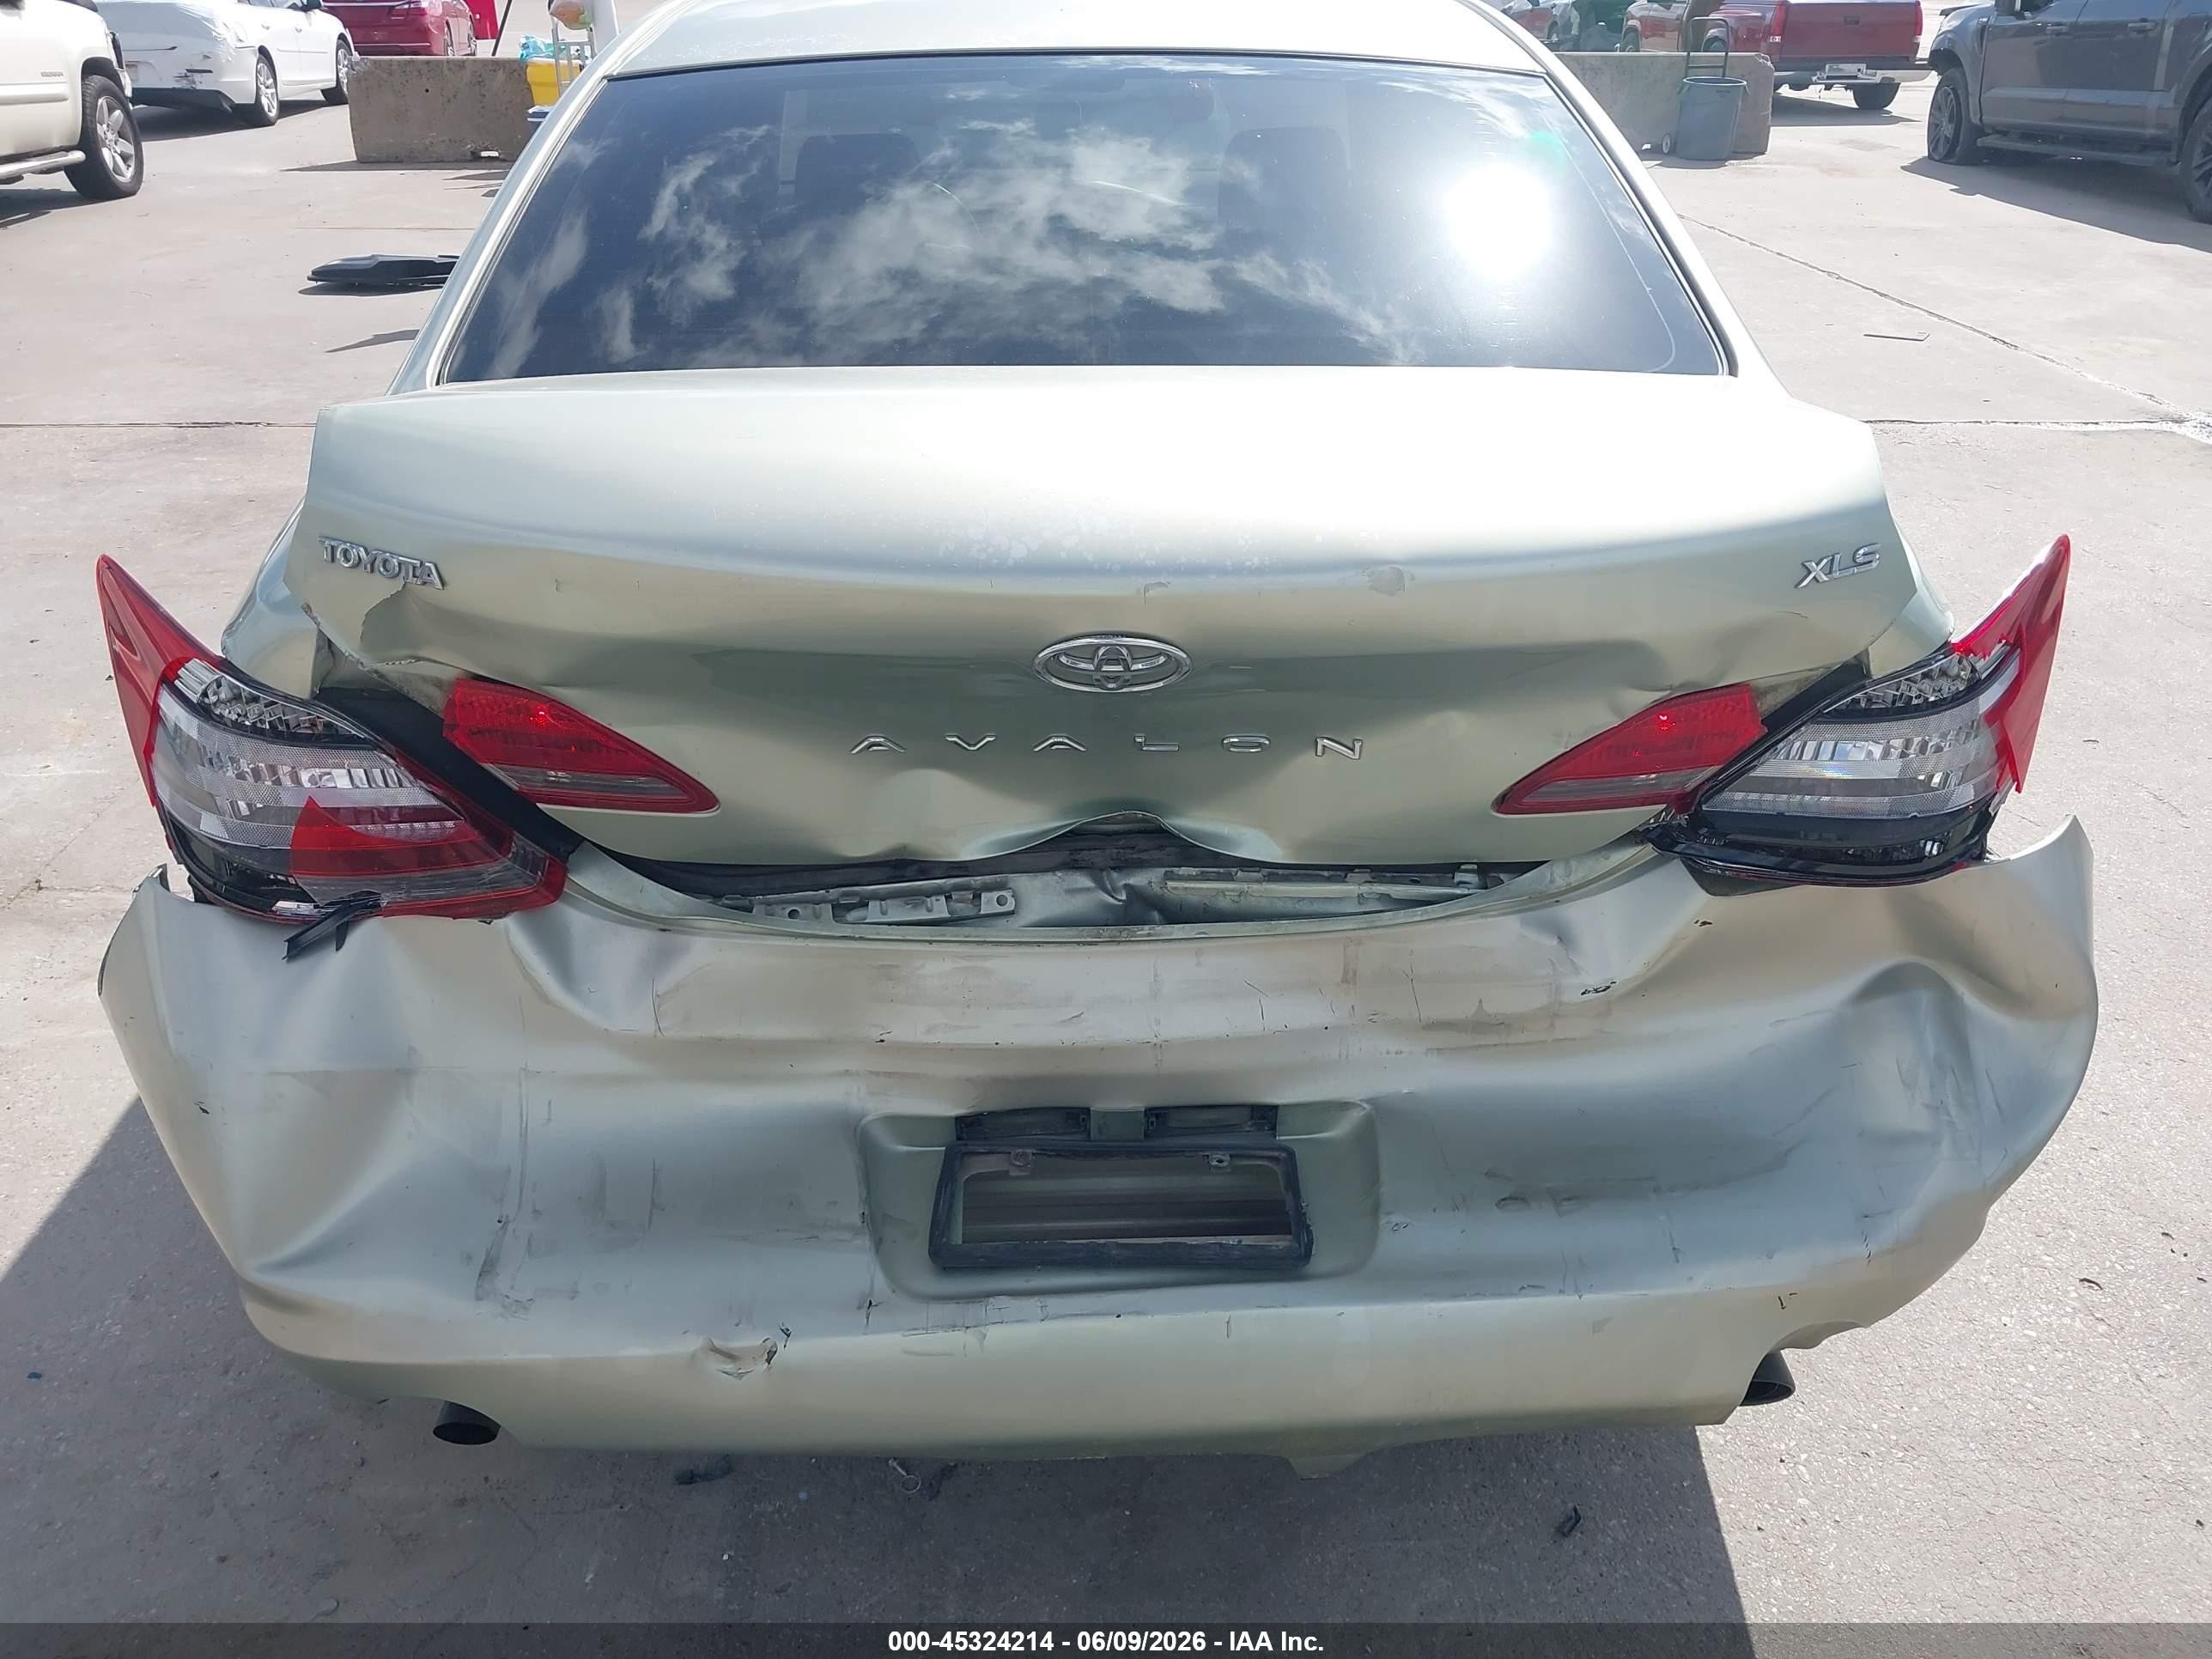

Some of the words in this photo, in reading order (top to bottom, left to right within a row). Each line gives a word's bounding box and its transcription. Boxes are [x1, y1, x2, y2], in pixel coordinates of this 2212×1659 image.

[319, 536, 446, 591] TOYOTA
[1794, 543, 1881, 589] XLS
[850, 734, 1364, 761] AVALON
